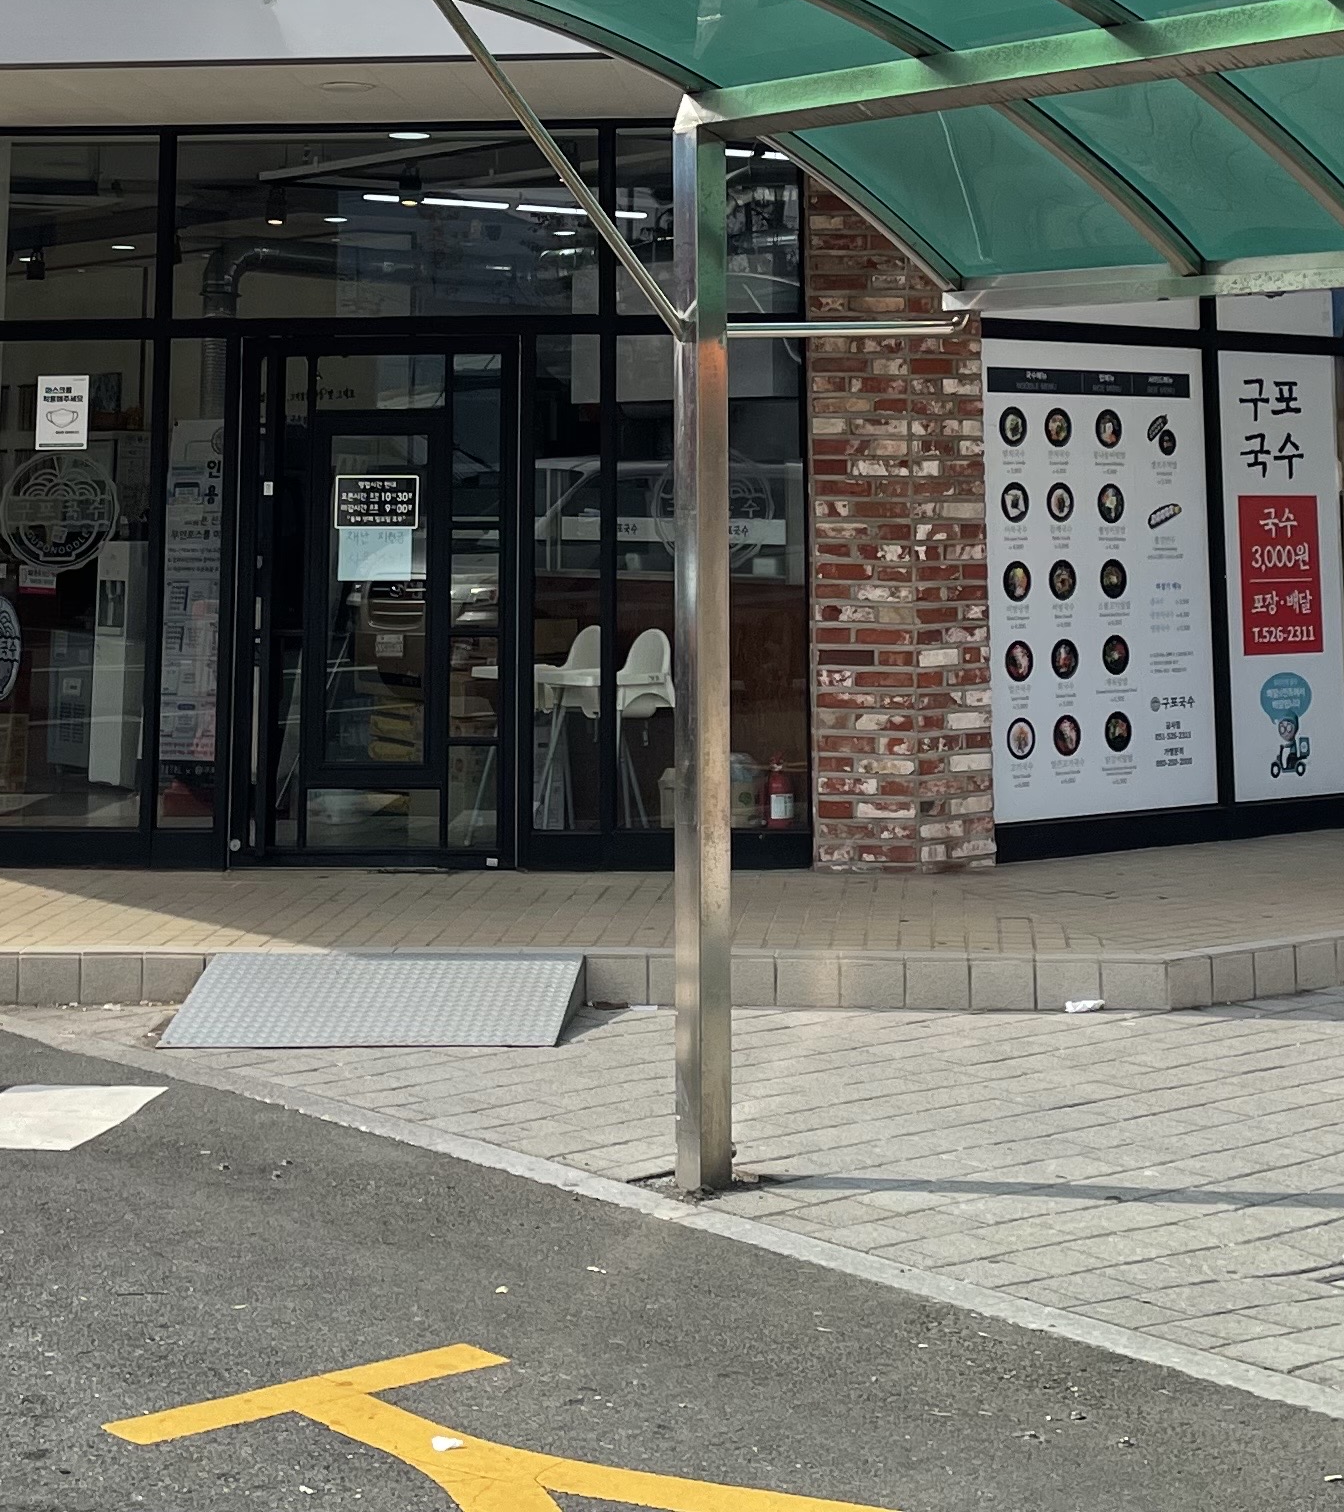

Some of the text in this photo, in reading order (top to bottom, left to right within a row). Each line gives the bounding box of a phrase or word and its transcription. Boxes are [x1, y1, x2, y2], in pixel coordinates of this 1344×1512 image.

[1238, 378, 1302, 422] 구포
[1239, 432, 1305, 480] 국수
[1258, 507, 1299, 539] 국수
[1251, 542, 1311, 573] 3,000원
[1251, 624, 1315, 644] T.526-2311
